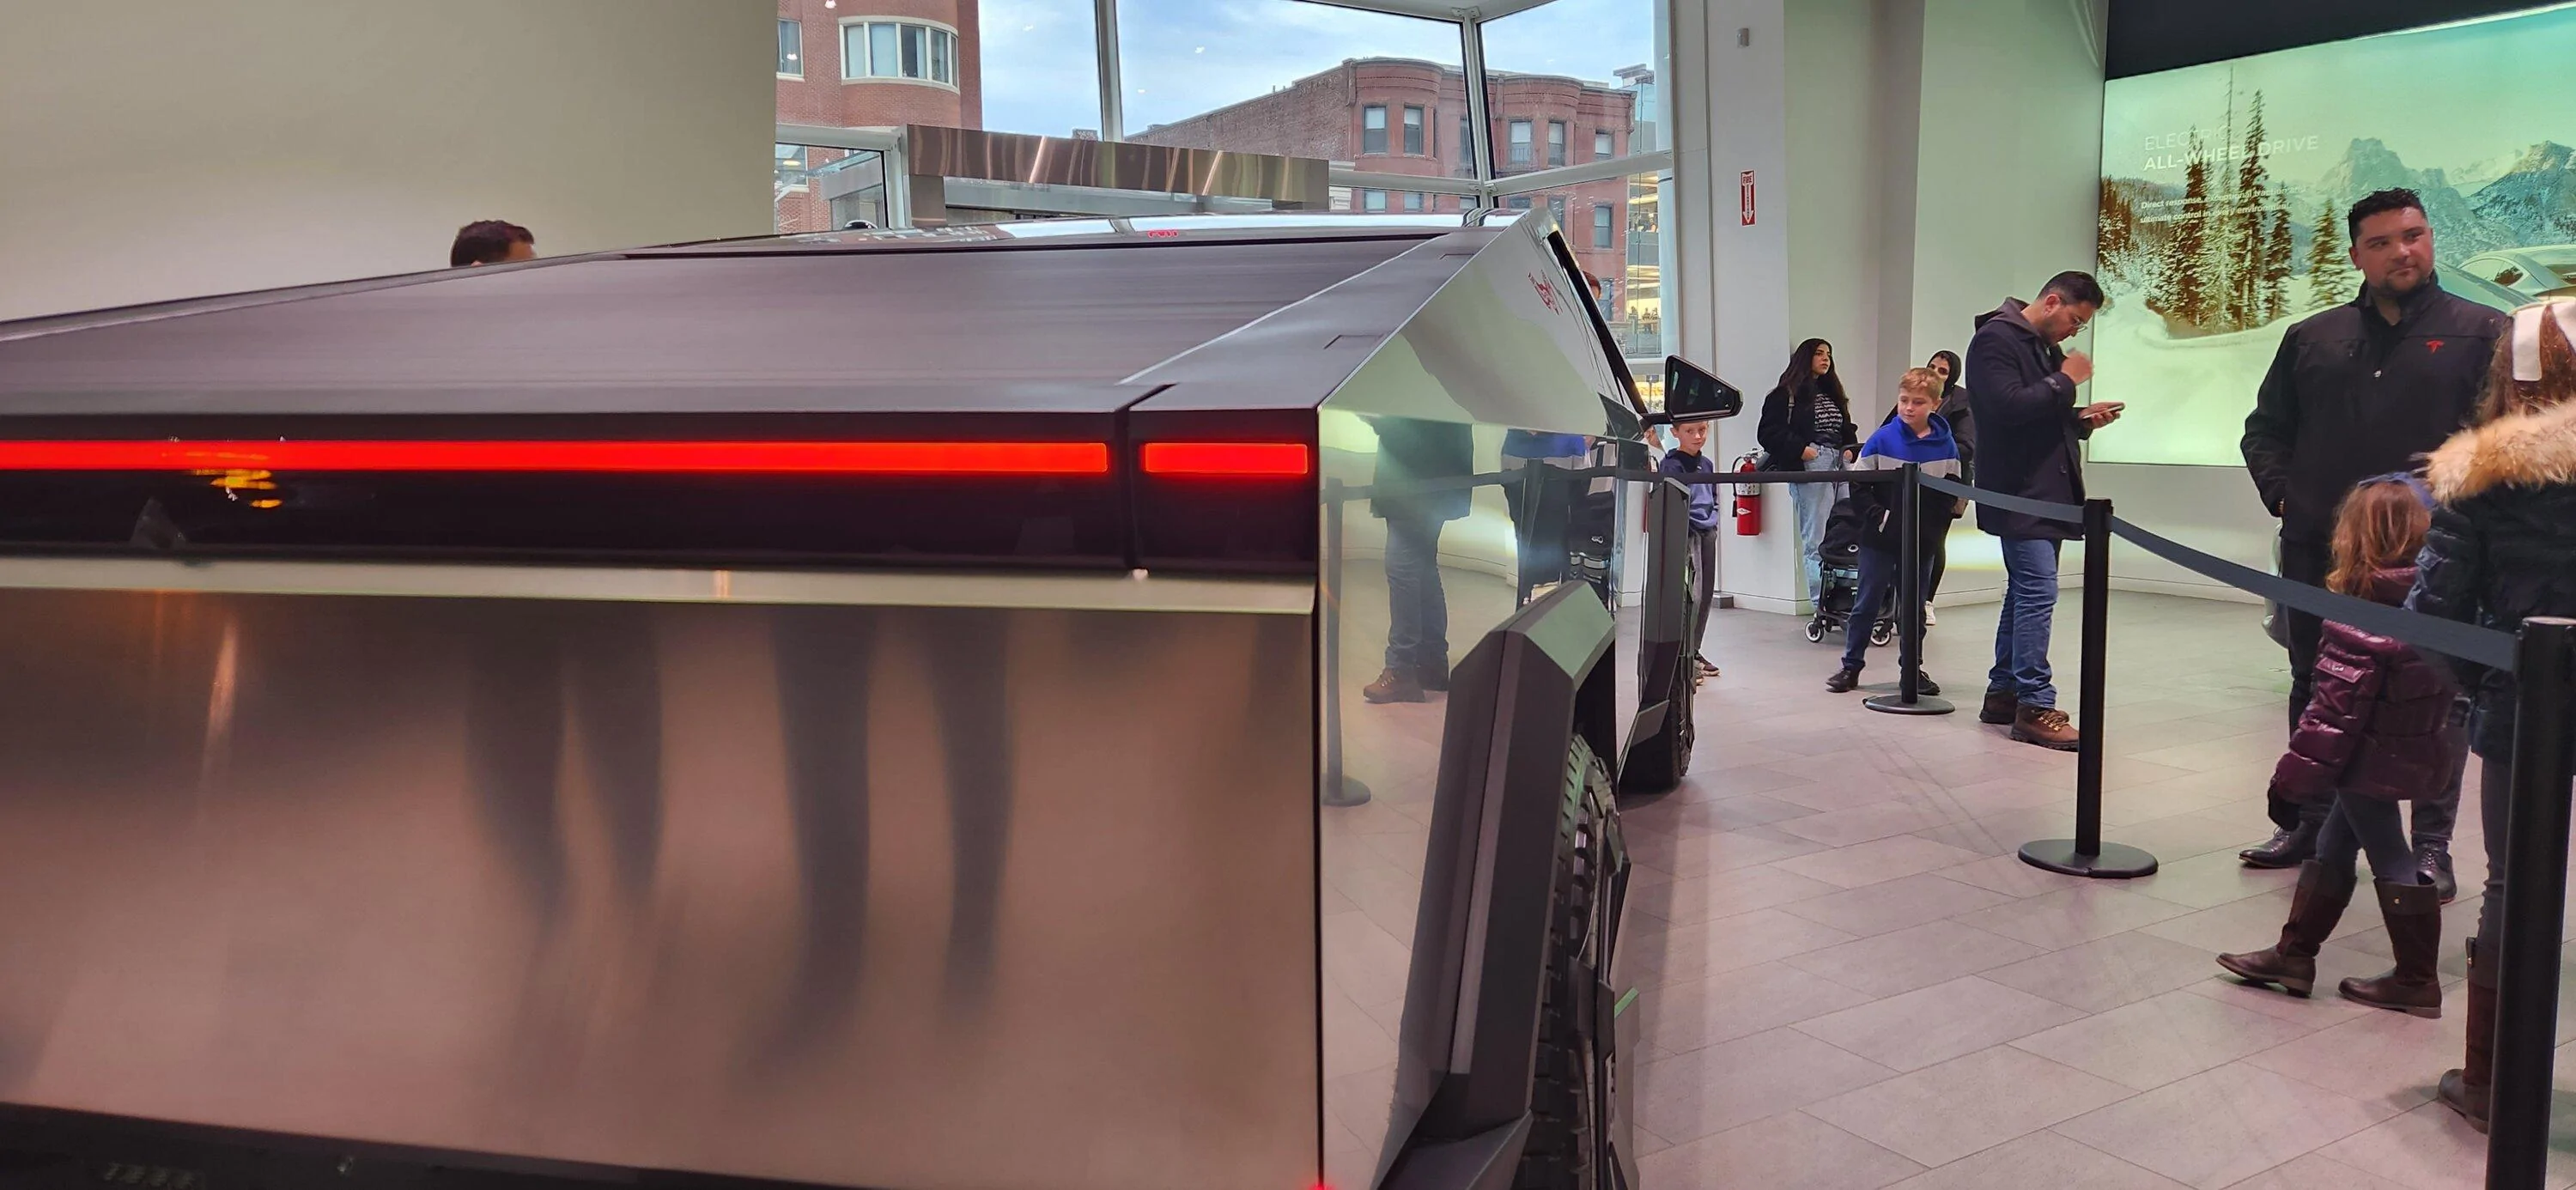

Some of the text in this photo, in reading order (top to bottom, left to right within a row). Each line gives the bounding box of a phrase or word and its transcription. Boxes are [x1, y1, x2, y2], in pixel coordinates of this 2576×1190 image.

[2143, 135, 2319, 171] ALL-WHEEL DRIVE
[2141, 200, 2165, 209] Direct
[2140, 213, 2172, 223] ultimate
[2172, 210, 2202, 221] control
[2202, 209, 2211, 219] in
